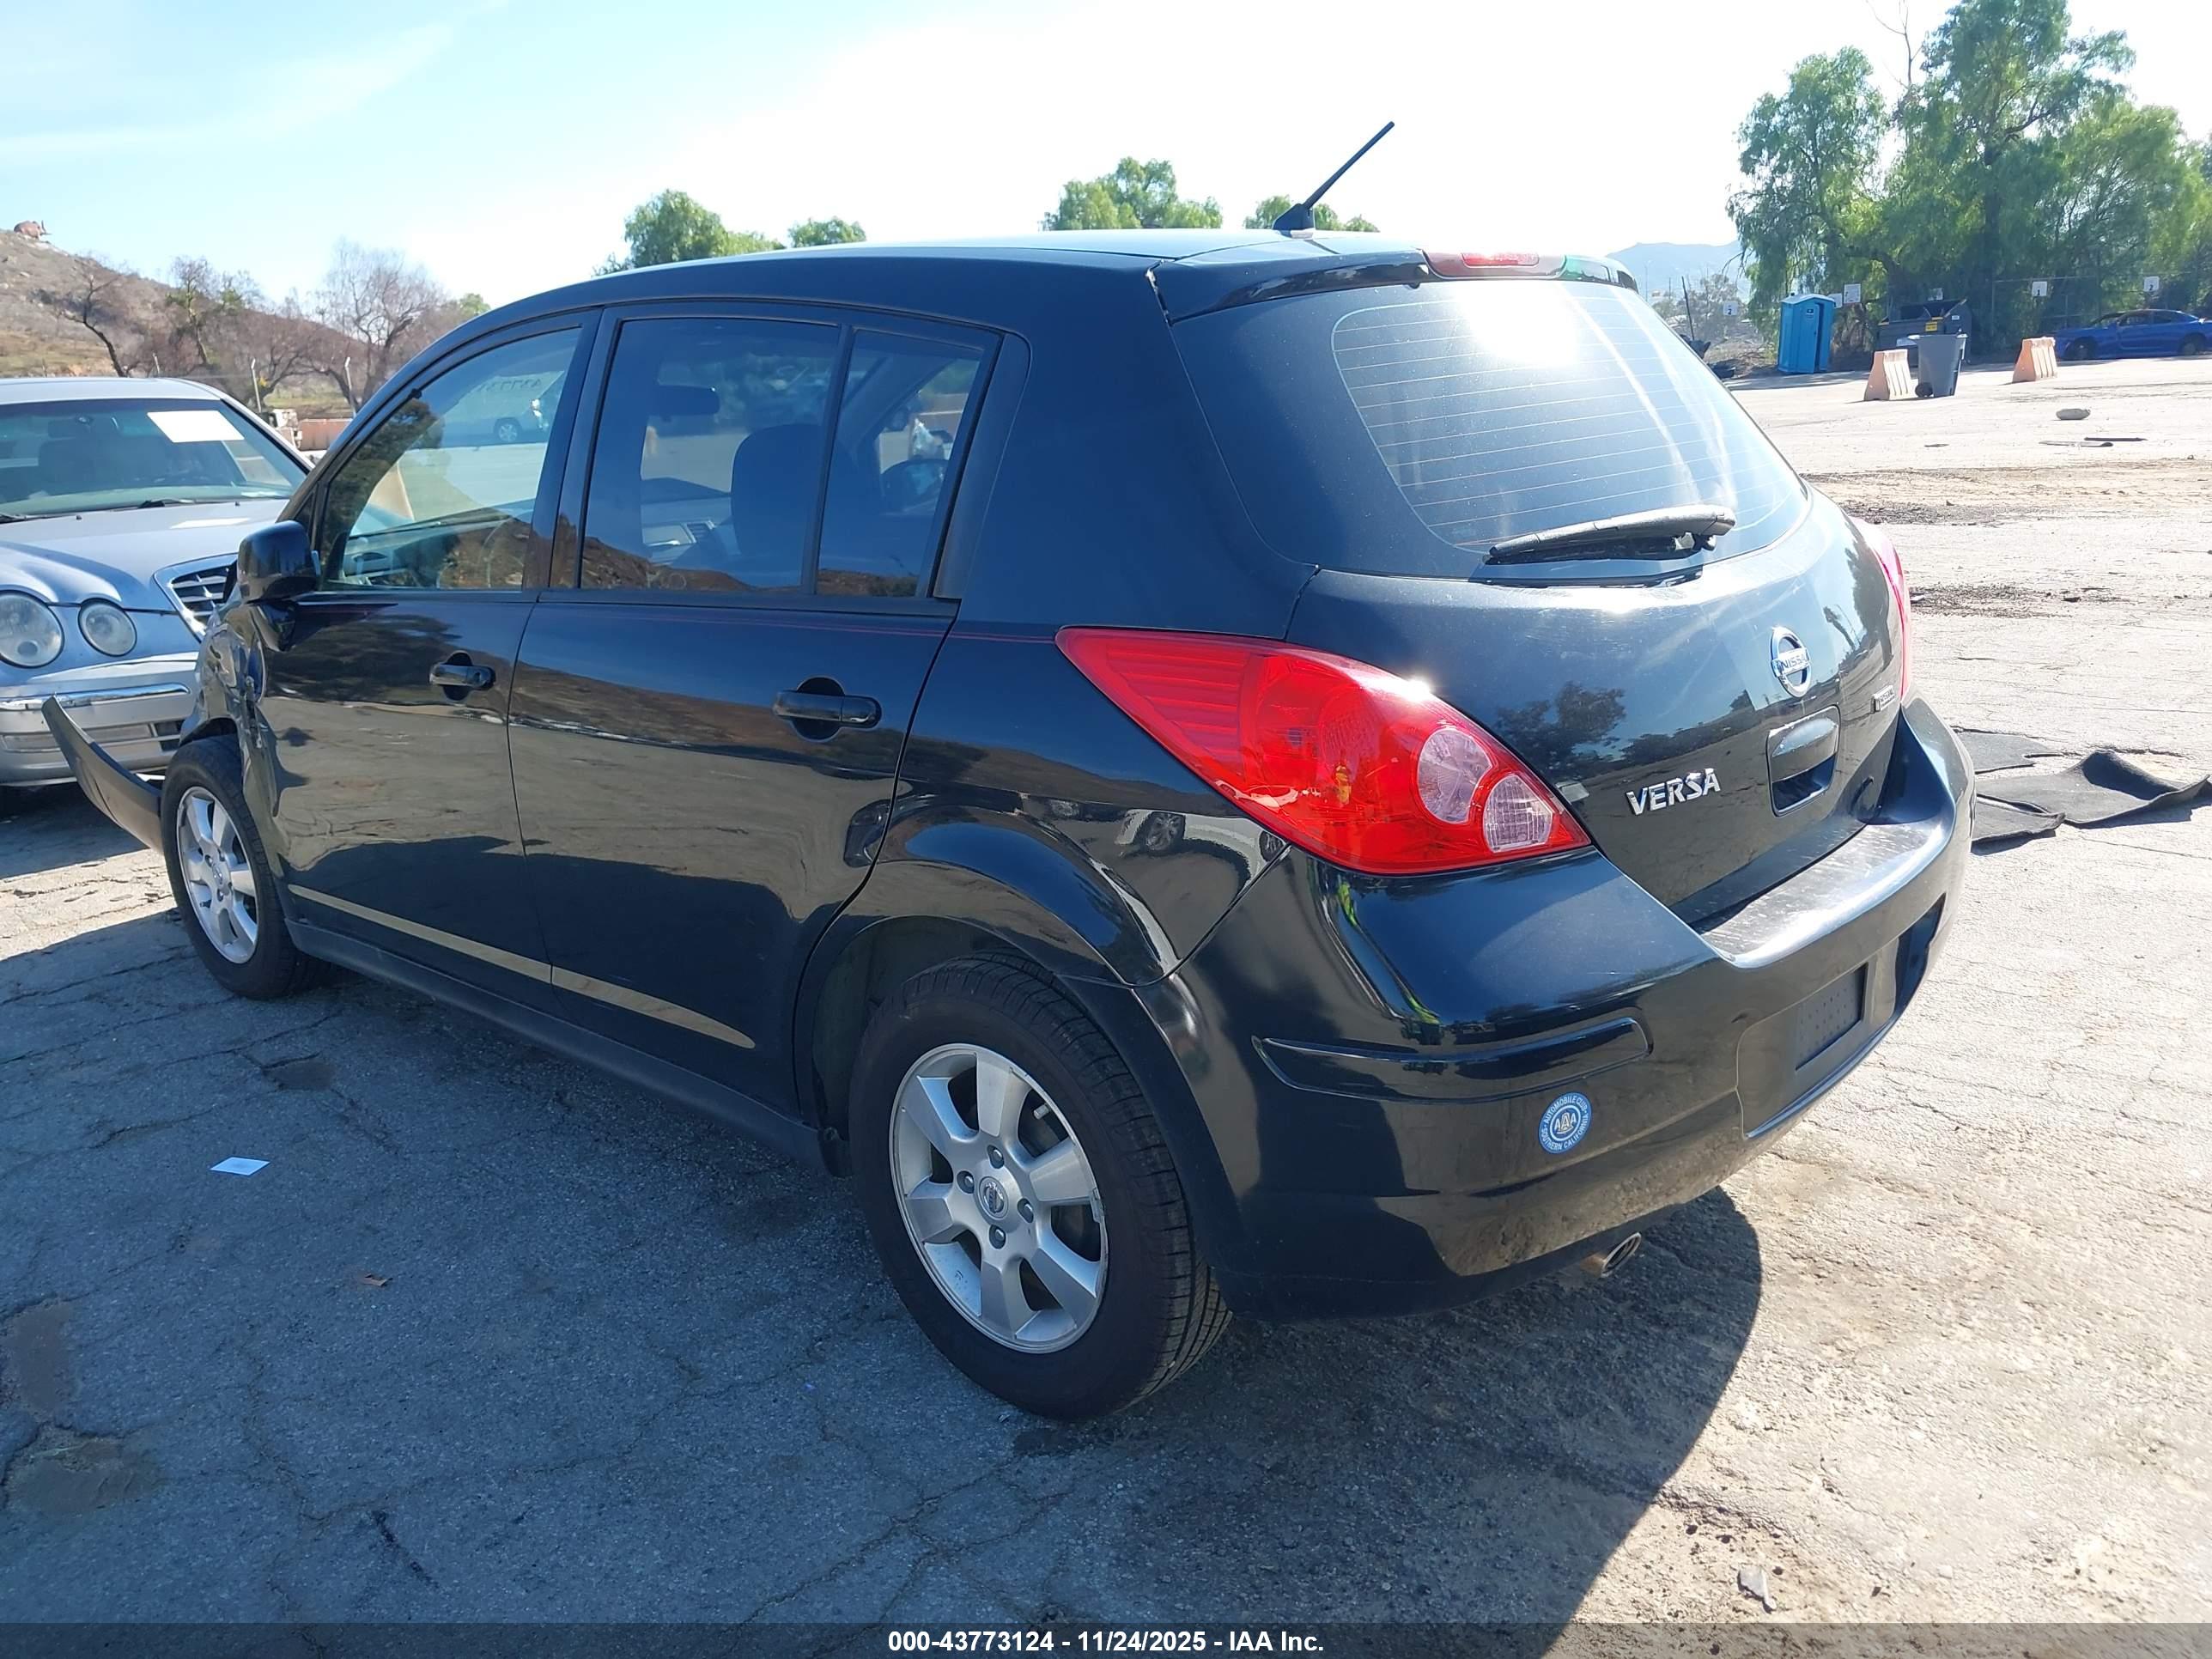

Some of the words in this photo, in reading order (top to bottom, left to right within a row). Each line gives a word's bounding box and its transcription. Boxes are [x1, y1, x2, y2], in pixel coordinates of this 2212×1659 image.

[1626, 768, 1721, 815] VERSA
[1545, 1095, 1577, 1123] AUTOMOBILE
[1576, 1097, 1588, 1113] CLUB
[1554, 1112, 1577, 1133] AAA
[1540, 1127, 1564, 1151] SOUTHERN
[1564, 1113, 1589, 1149] CALIFORNIA
